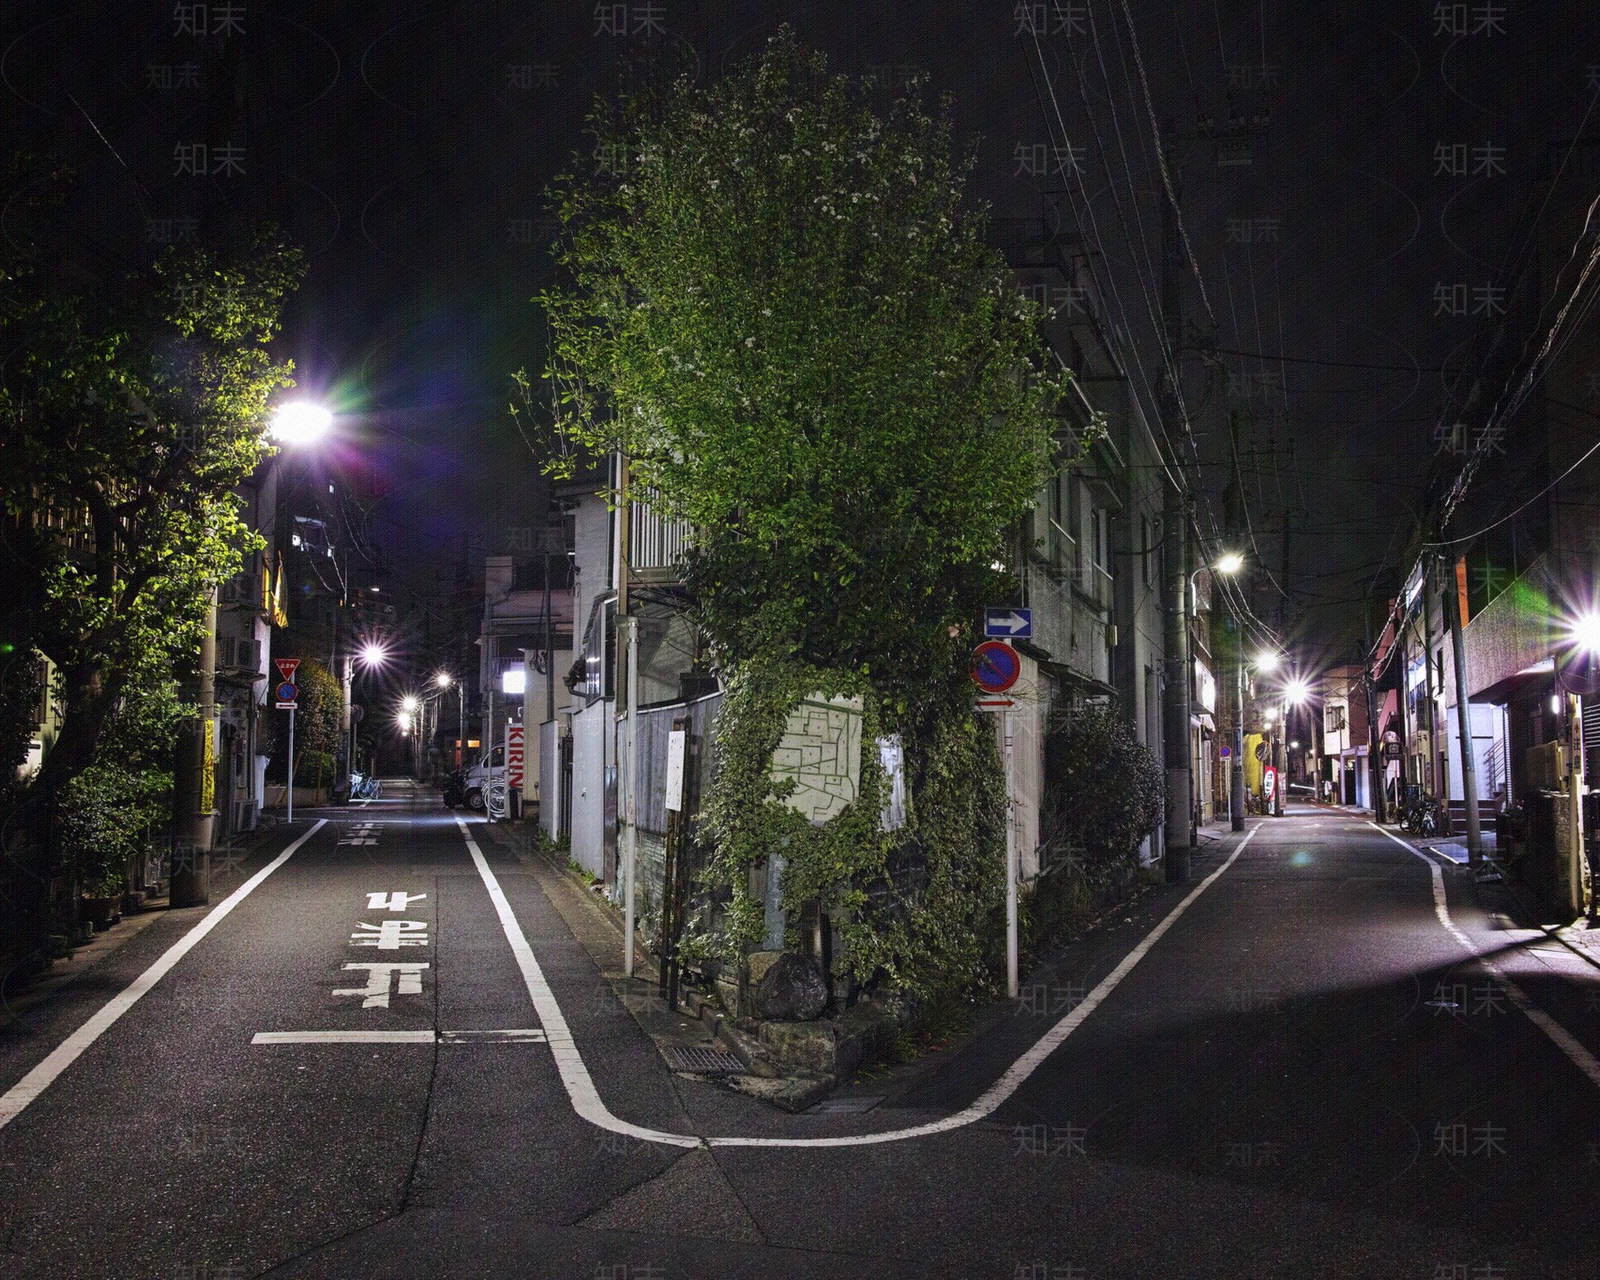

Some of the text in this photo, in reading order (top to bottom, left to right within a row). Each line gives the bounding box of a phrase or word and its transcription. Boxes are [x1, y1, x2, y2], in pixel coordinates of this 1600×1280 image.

[508, 727, 524, 790] KIRIN
[332, 892, 430, 1009] 止まれ
